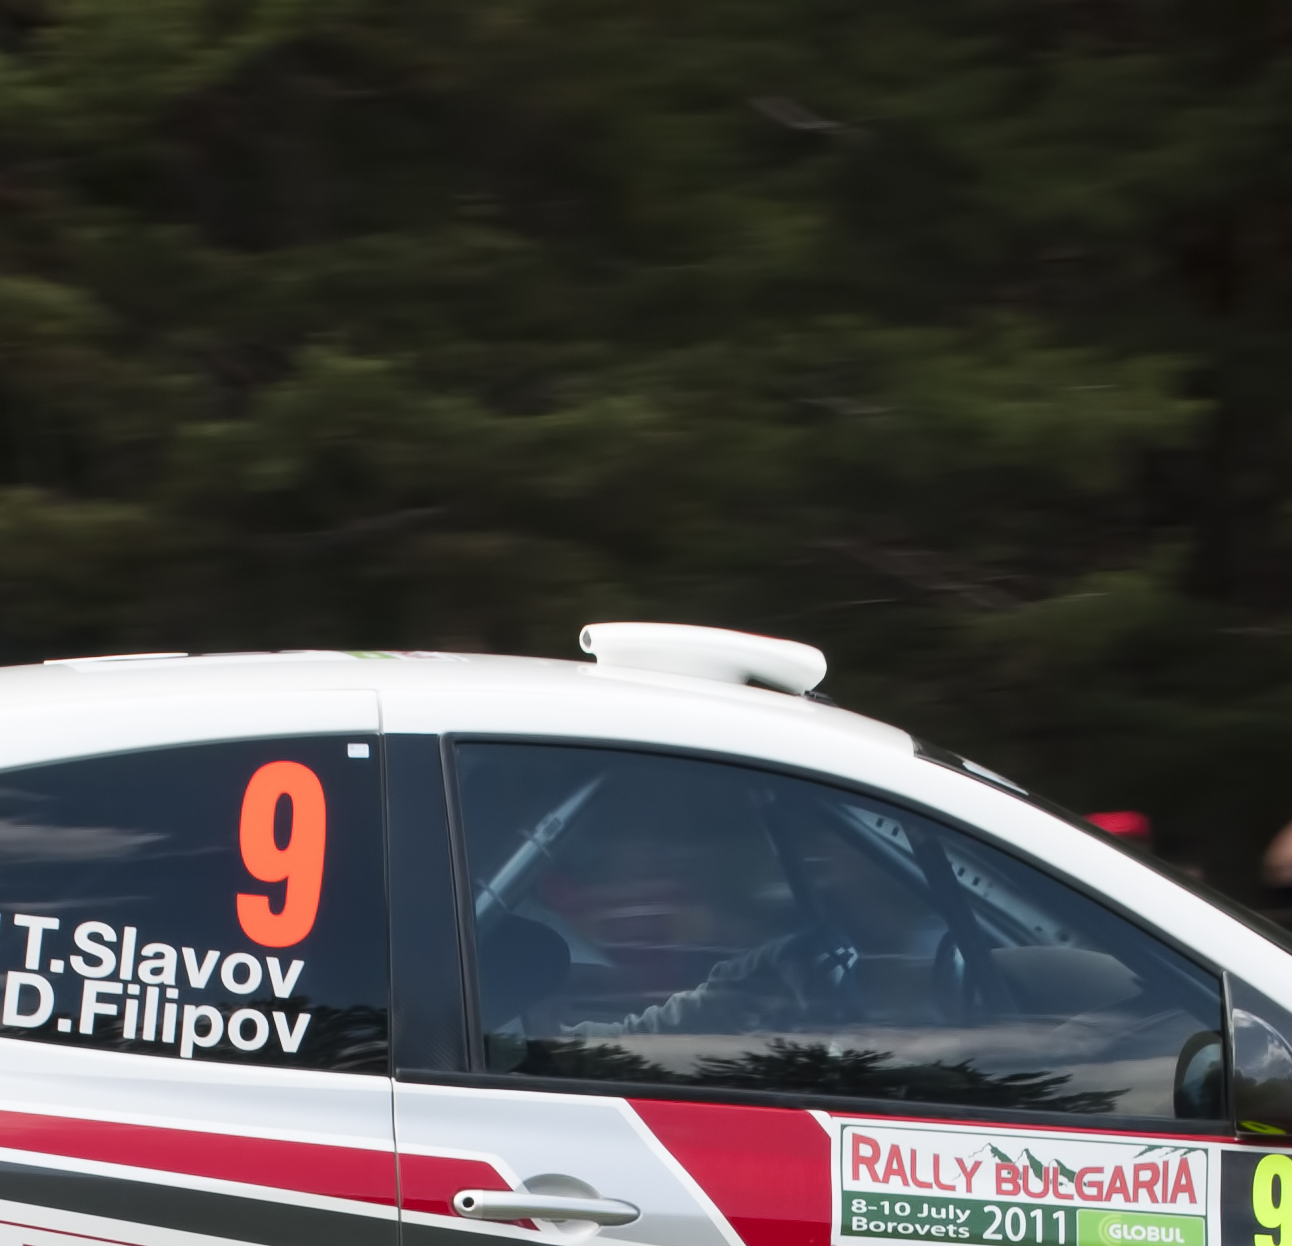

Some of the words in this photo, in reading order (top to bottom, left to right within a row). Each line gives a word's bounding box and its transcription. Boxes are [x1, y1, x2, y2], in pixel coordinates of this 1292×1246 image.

[236, 760, 326, 948] 9
[13, 914, 305, 999] T.Slavov
[3, 970, 311, 1059] D.Filipov
[852, 1132, 982, 1194] RALLY
[995, 1157, 1197, 1205] BULGARIA
[851, 1198, 911, 1217] 8-10
[918, 1202, 971, 1224] July
[852, 1216, 970, 1239] Borovets
[982, 1204, 1067, 1245] 2011
[1108, 1222, 1185, 1244] GLOBUL
